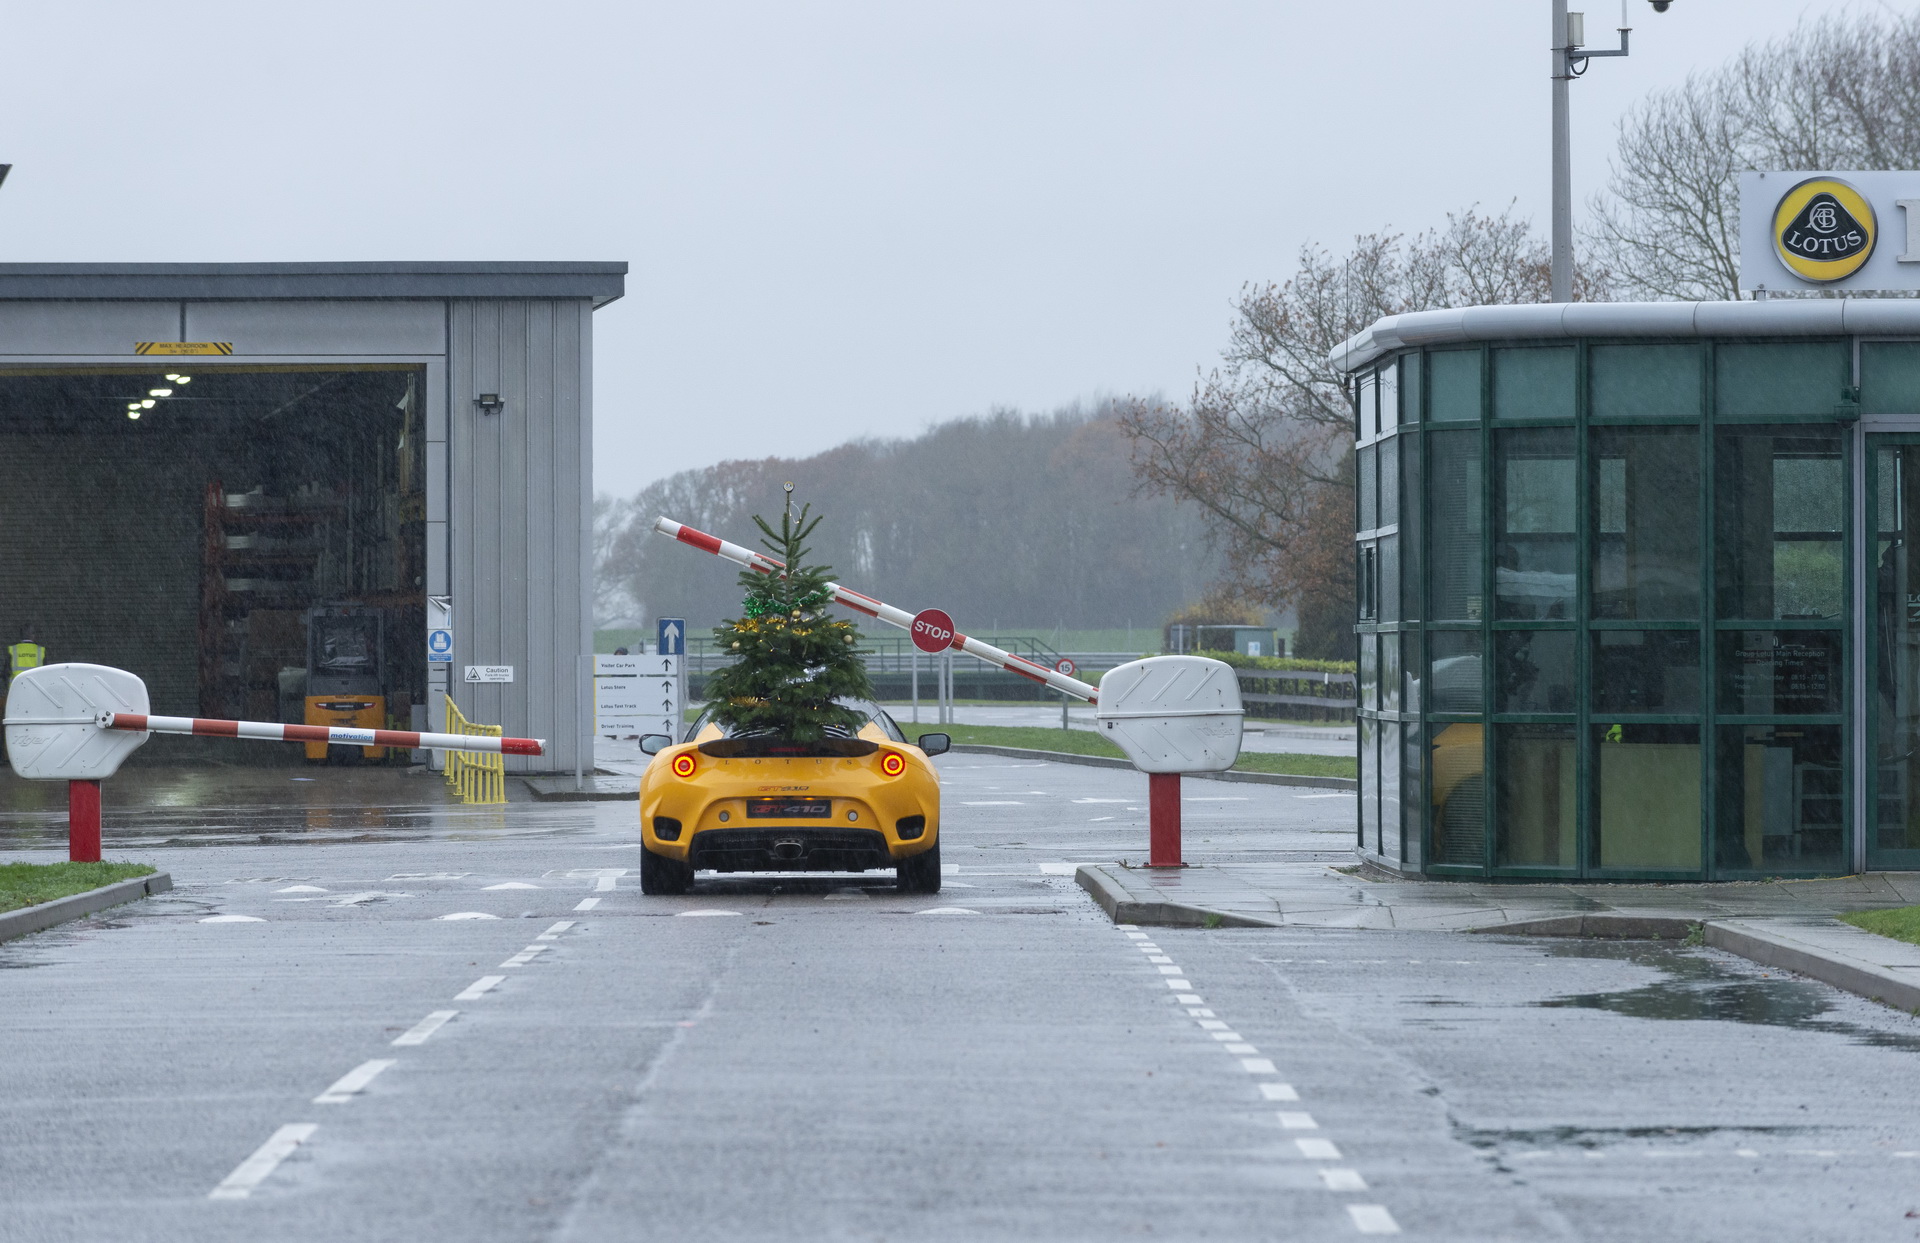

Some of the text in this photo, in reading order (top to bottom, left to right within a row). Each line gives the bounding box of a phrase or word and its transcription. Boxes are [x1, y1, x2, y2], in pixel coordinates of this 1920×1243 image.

[1787, 230, 1862, 254] LOTUS
[914, 620, 951, 641] STOP
[1793, 650, 1824, 658] Reception
[1060, 664, 1071, 672] 15
[751, 804, 827, 814] GT410
